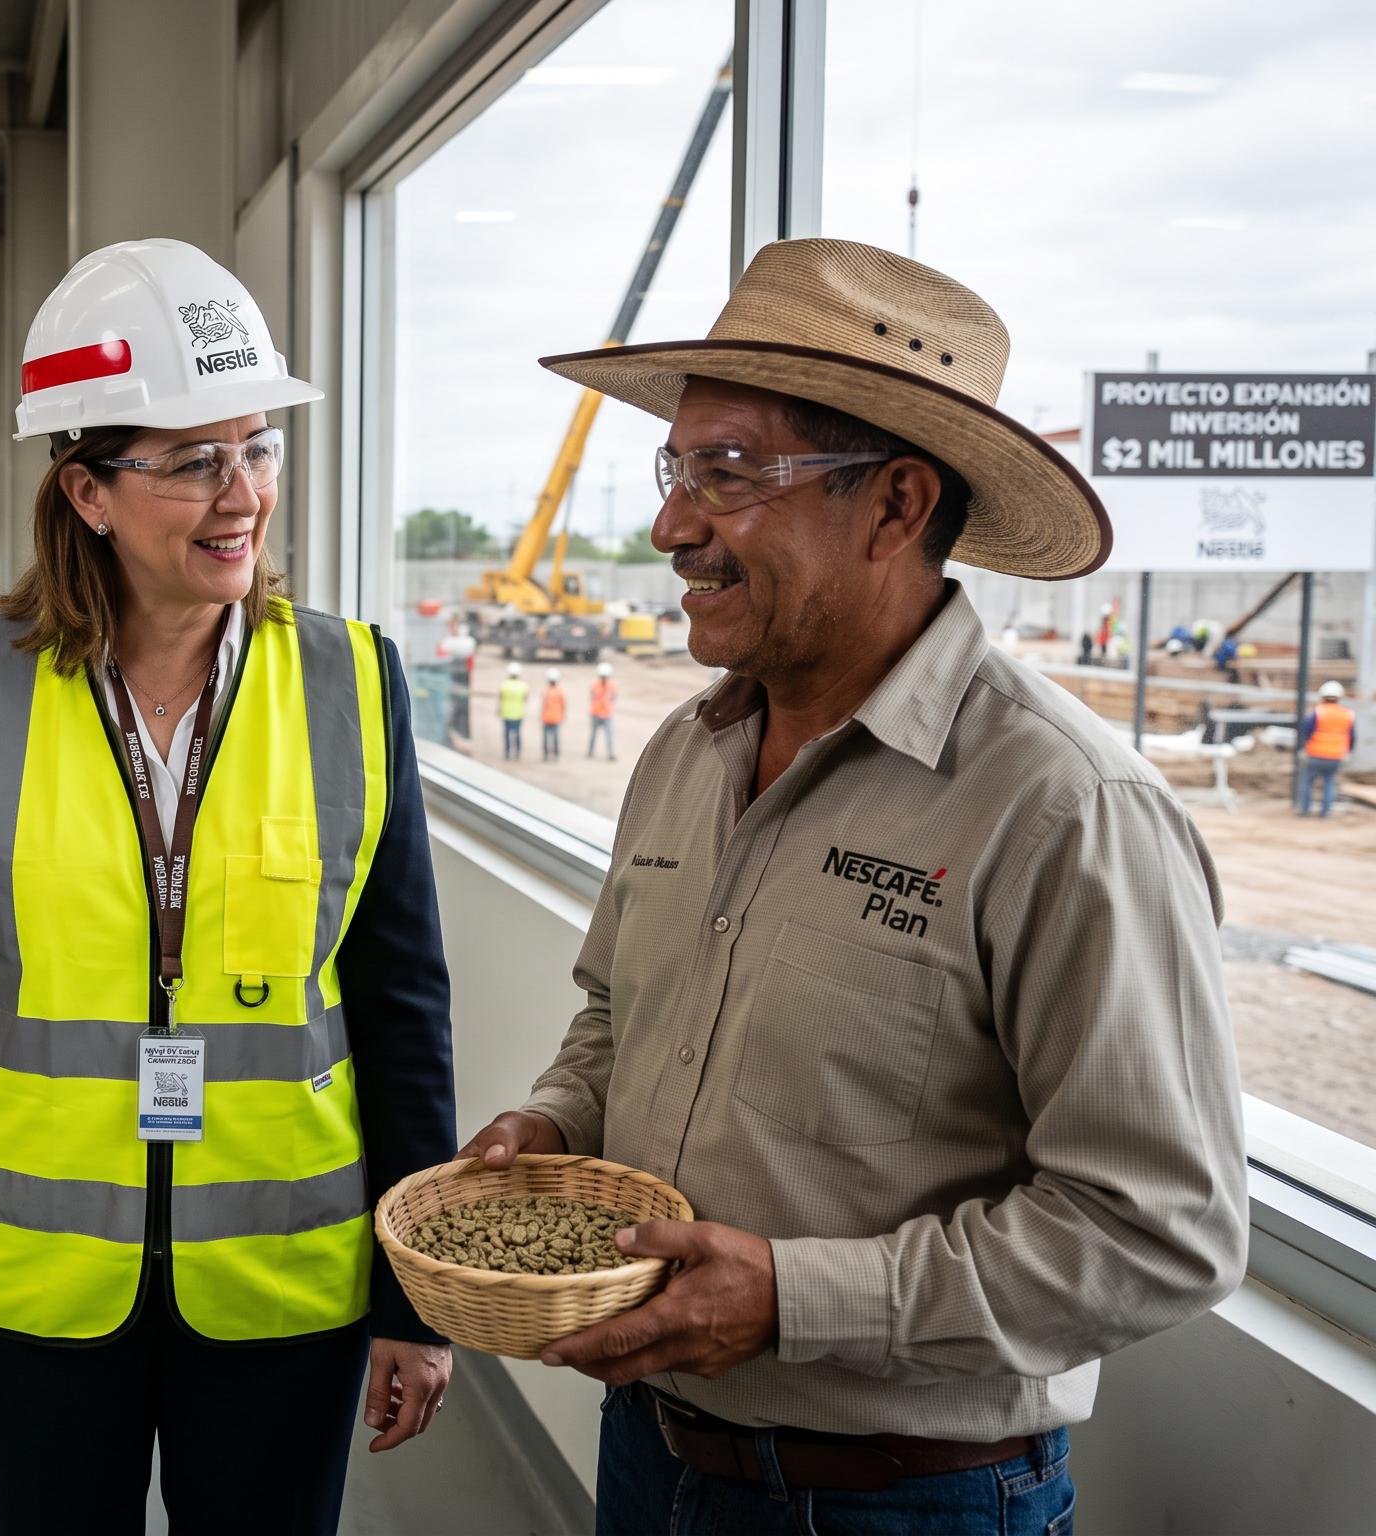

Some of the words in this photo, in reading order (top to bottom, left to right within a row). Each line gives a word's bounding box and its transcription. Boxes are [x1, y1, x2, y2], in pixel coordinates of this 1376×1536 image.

[195, 346, 258, 376] Nestlé
[1102, 382, 1230, 407] PROYECTO
[1233, 378, 1370, 407] EXPANSIÓN
[1170, 408, 1300, 435] INVERSIÓN
[1101, 436, 1142, 472] $2
[1148, 440, 1203, 469] MIL
[1209, 440, 1366, 470] MILLONES
[821, 846, 948, 906] NESCAFÉ
[860, 892, 929, 938] Plan
